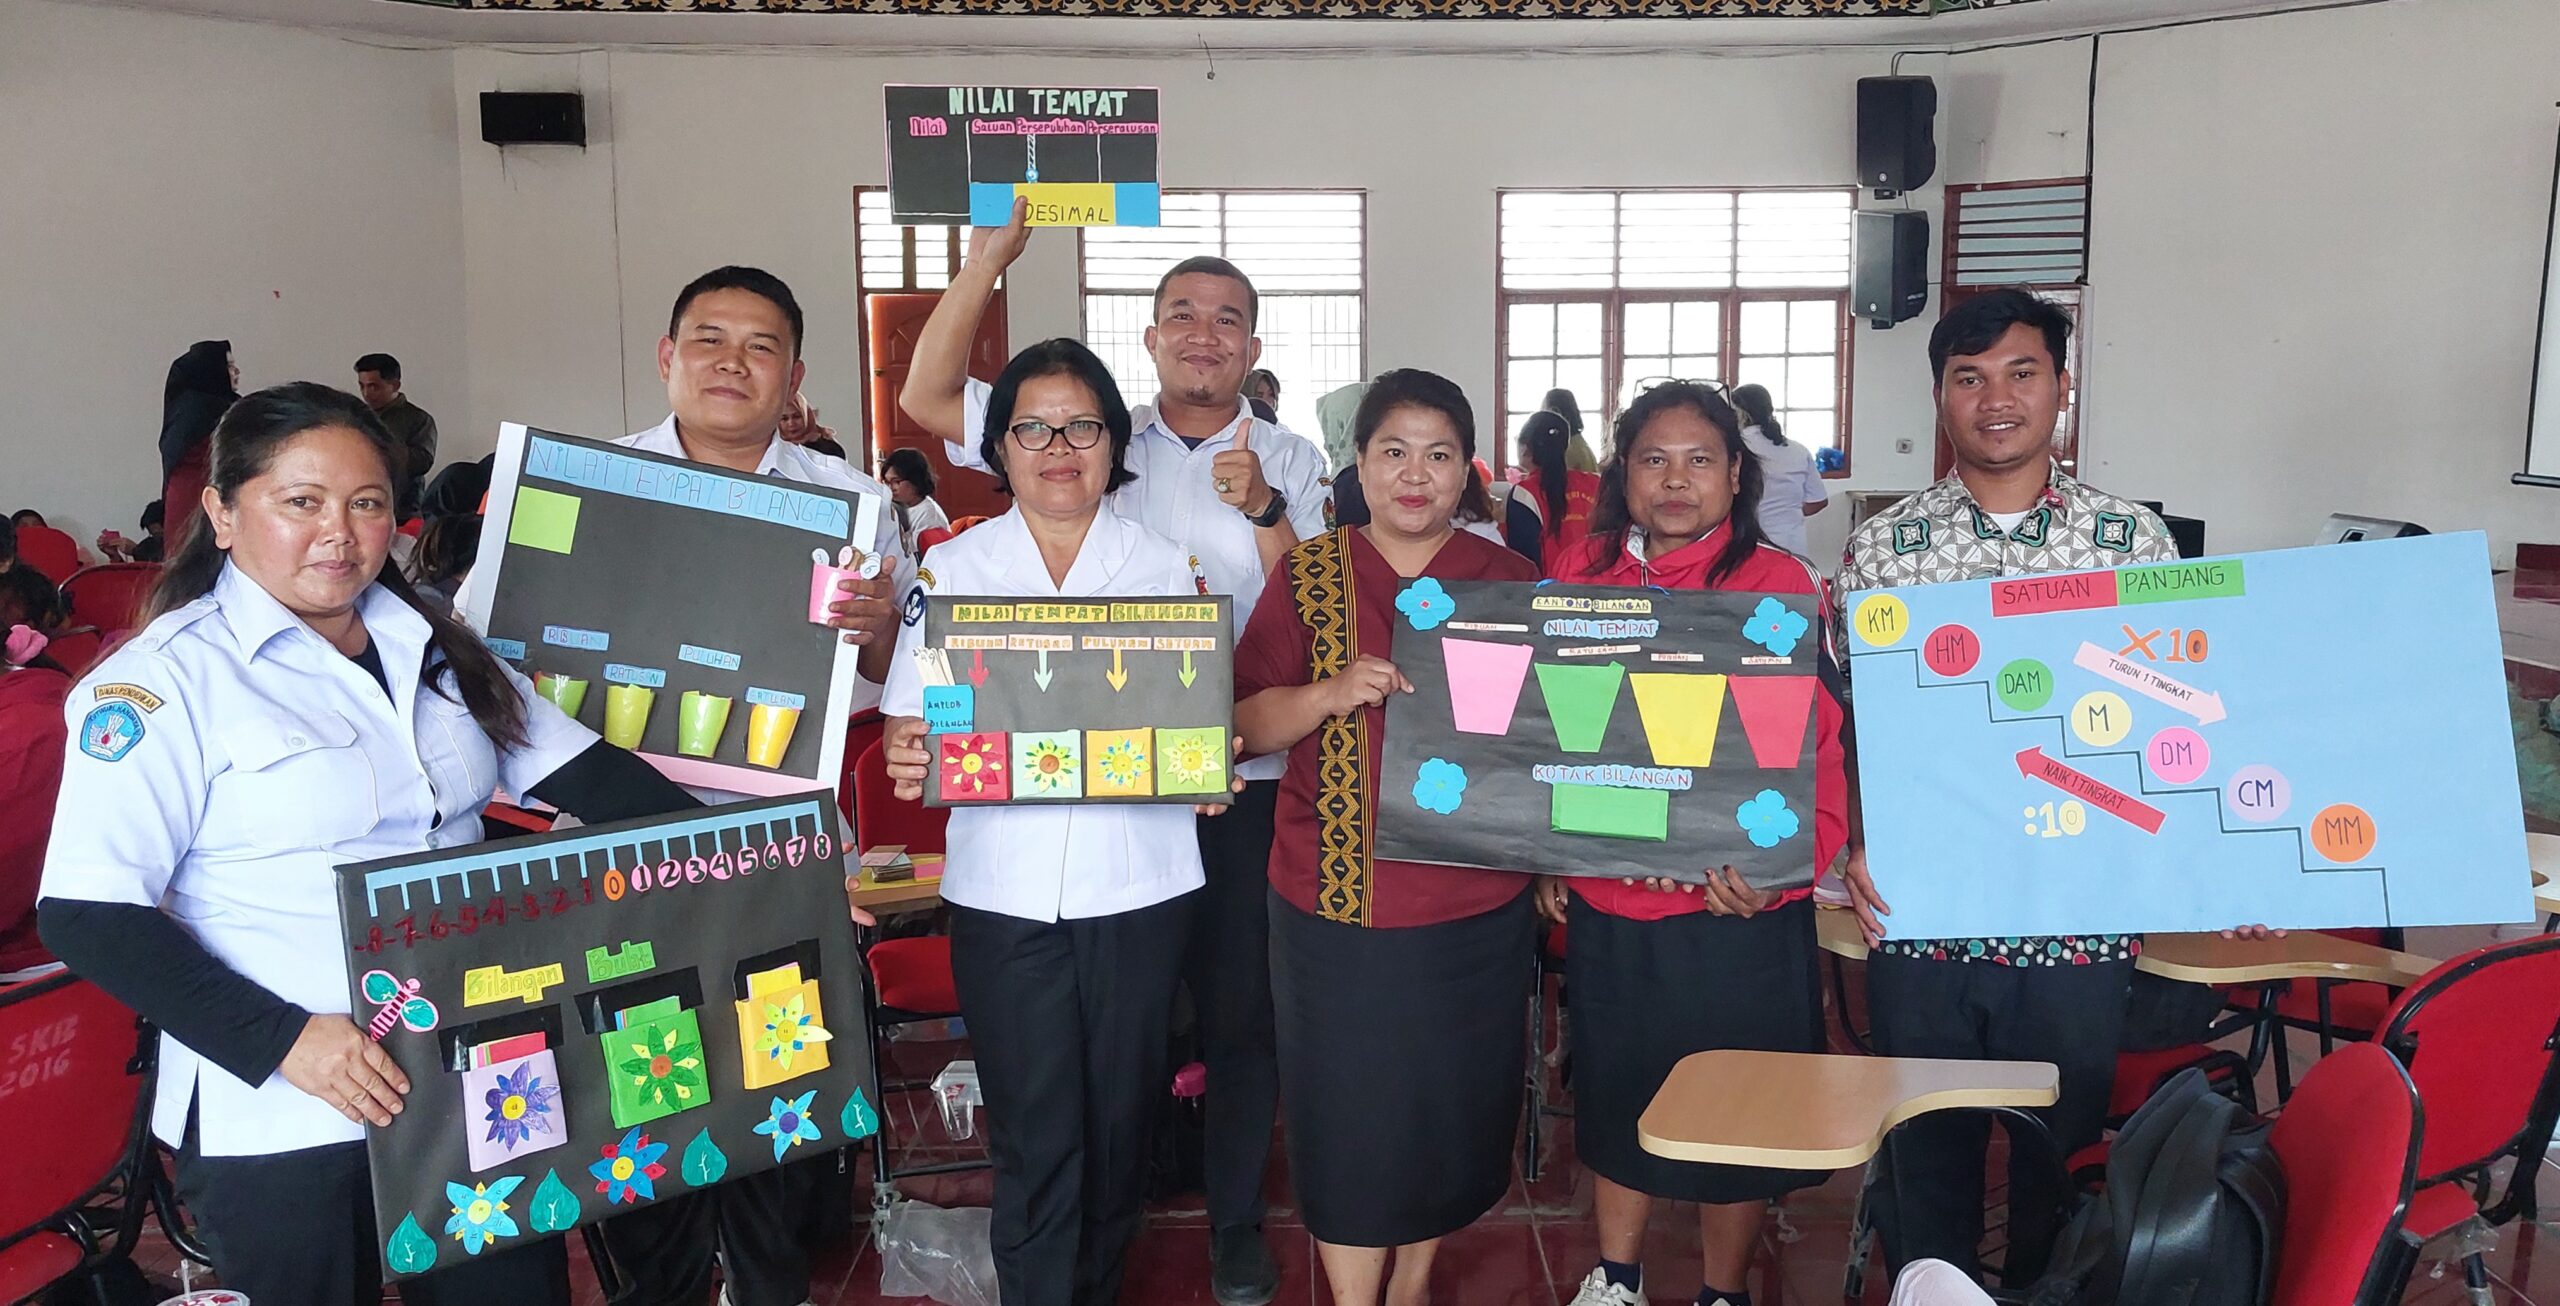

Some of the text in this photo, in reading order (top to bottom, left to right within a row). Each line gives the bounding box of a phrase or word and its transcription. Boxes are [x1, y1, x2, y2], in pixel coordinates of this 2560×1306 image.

[948, 87, 1128, 117] NILAI TEMPAT
[911, 118, 943, 135] Nilai
[1015, 117, 1084, 133] Persepuluhan
[1025, 203, 1109, 222] DESIMAL
[615, 459, 722, 504] TEMPAT
[864, 564, 878, 574] 6
[2003, 565, 2224, 604] SATUAN PANJANG
[958, 604, 1214, 621] NILAI TEMPAT BILANGAN
[1536, 598, 1650, 611] KANTONG BILANGAN
[1867, 605, 1895, 633] KM
[1546, 623, 1656, 636] NILAI TEMPAT
[1935, 632, 1967, 664] HM
[2004, 670, 2041, 695] DAM
[2109, 658, 2193, 702] TURUN 1 TINGKAT
[2088, 703, 2110, 732] M
[2160, 741, 2193, 766] DM
[1534, 766, 1690, 787] KOTAK BILANGAN
[2043, 761, 2127, 810] NAIK 1 TINGKAT
[2238, 779, 2275, 808] CM
[2324, 815, 2363, 847] MM
[609, 876, 620, 895] 0
[639, 865, 648, 889] 1
[659, 861, 680, 885] 2
[692, 859, 707, 882] 3
[712, 852, 731, 877] 4
[739, 848, 757, 875] 5
[765, 842, 780, 869] 6
[786, 836, 805, 865] 7
[816, 834, 828, 859] 8
[589, 944, 652, 980] Bulat
[466, 966, 560, 1000] Bilangan
[0, 1047, 71, 1098] 2016
